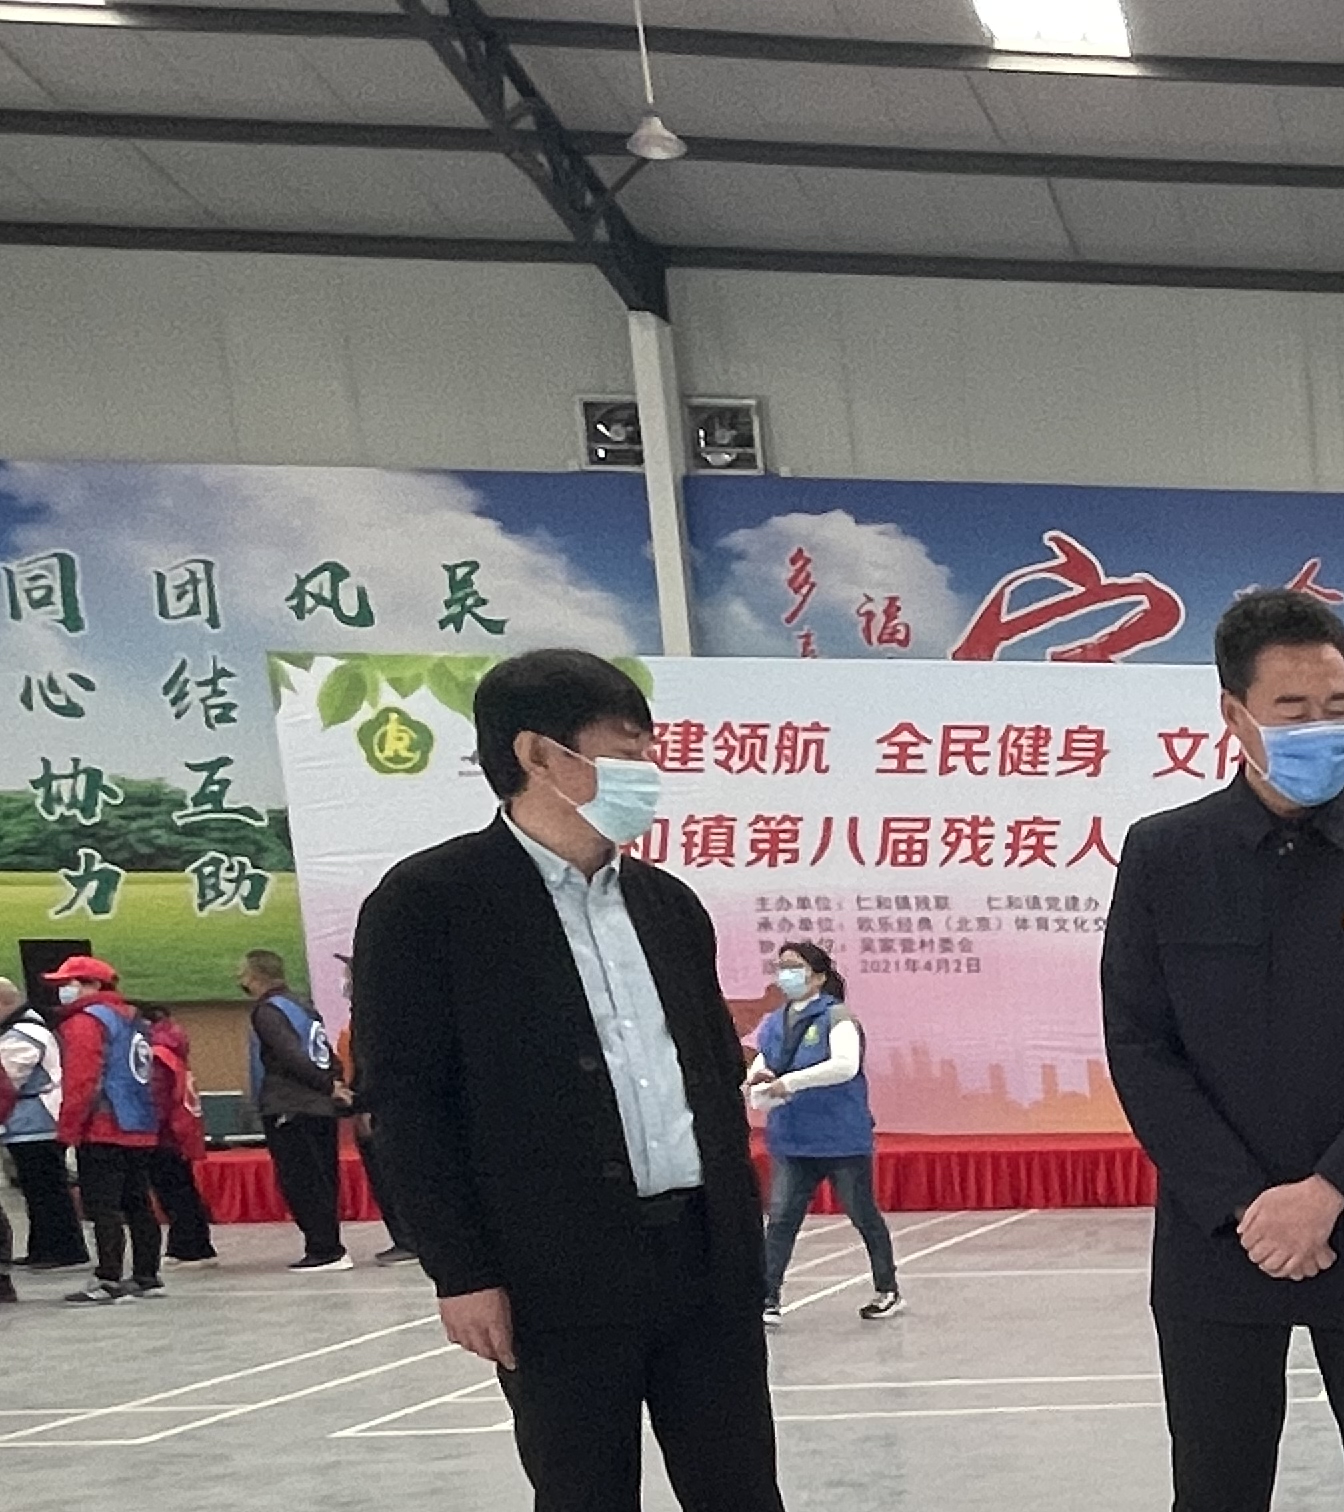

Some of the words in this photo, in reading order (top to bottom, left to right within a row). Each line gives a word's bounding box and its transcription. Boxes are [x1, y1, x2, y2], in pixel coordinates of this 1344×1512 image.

[153, 558, 269, 914] 团结互助
[875, 722, 1110, 777] 全民健身
[860, 957, 981, 974] 2021年4月2日
